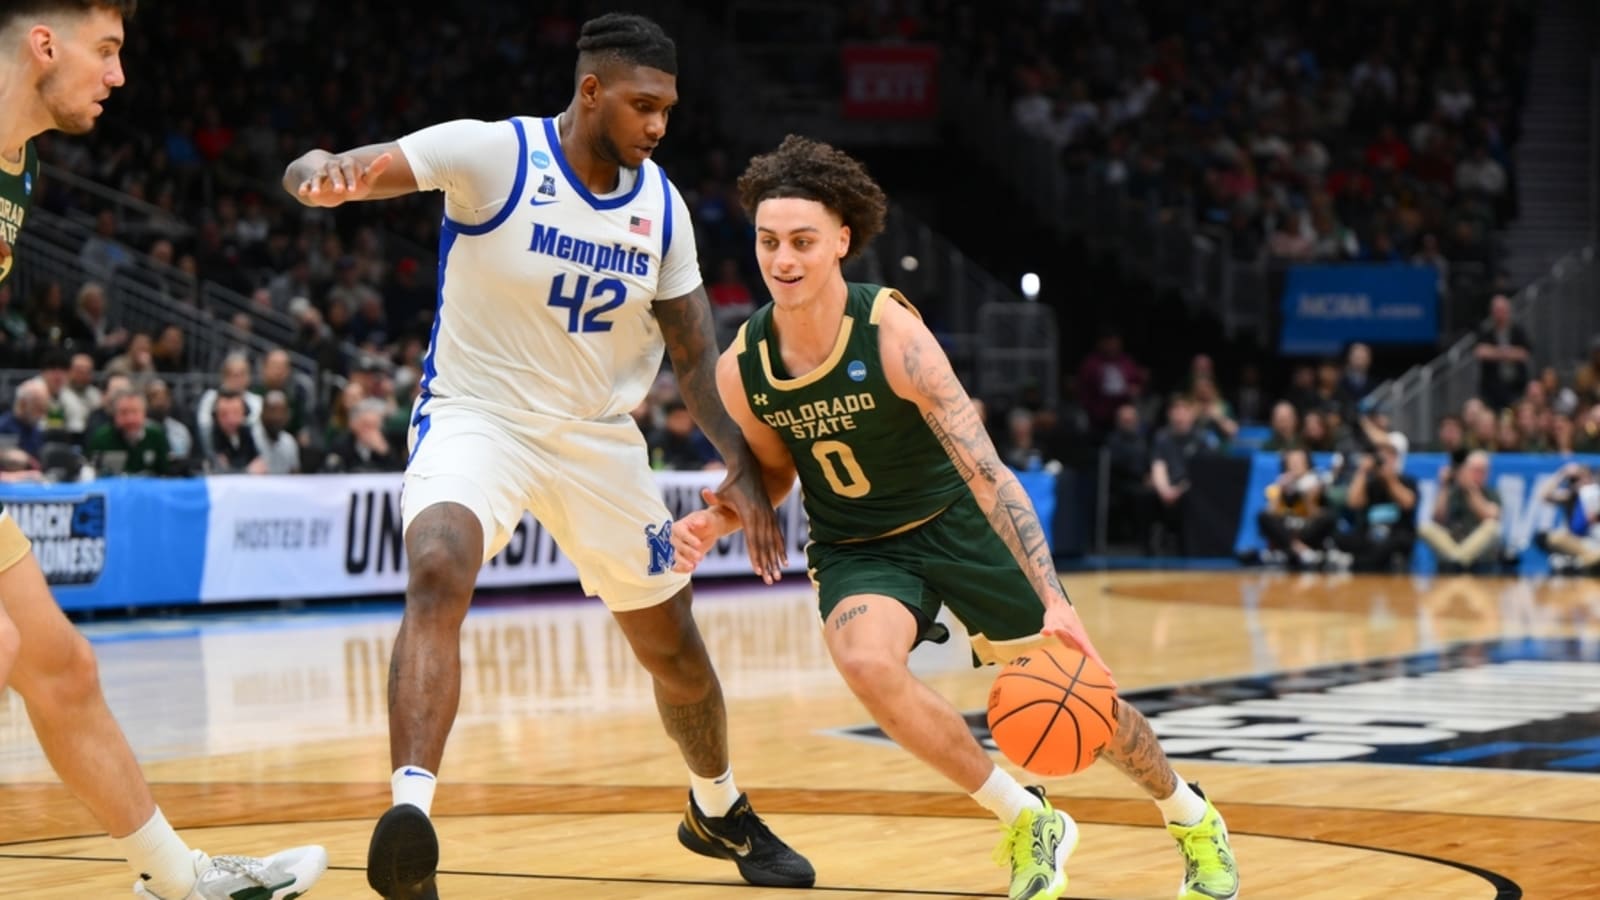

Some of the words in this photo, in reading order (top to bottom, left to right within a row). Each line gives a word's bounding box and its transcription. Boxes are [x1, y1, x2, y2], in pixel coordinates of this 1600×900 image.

[528, 222, 649, 277] Memphis
[547, 272, 627, 333] 42
[763, 392, 876, 428] COLORADO
[790, 415, 856, 439] STATE
[811, 440, 872, 498] 0
[232, 518, 304, 549] HOSTED
[309, 518, 333, 548] BY
[834, 604, 868, 631] 1989
